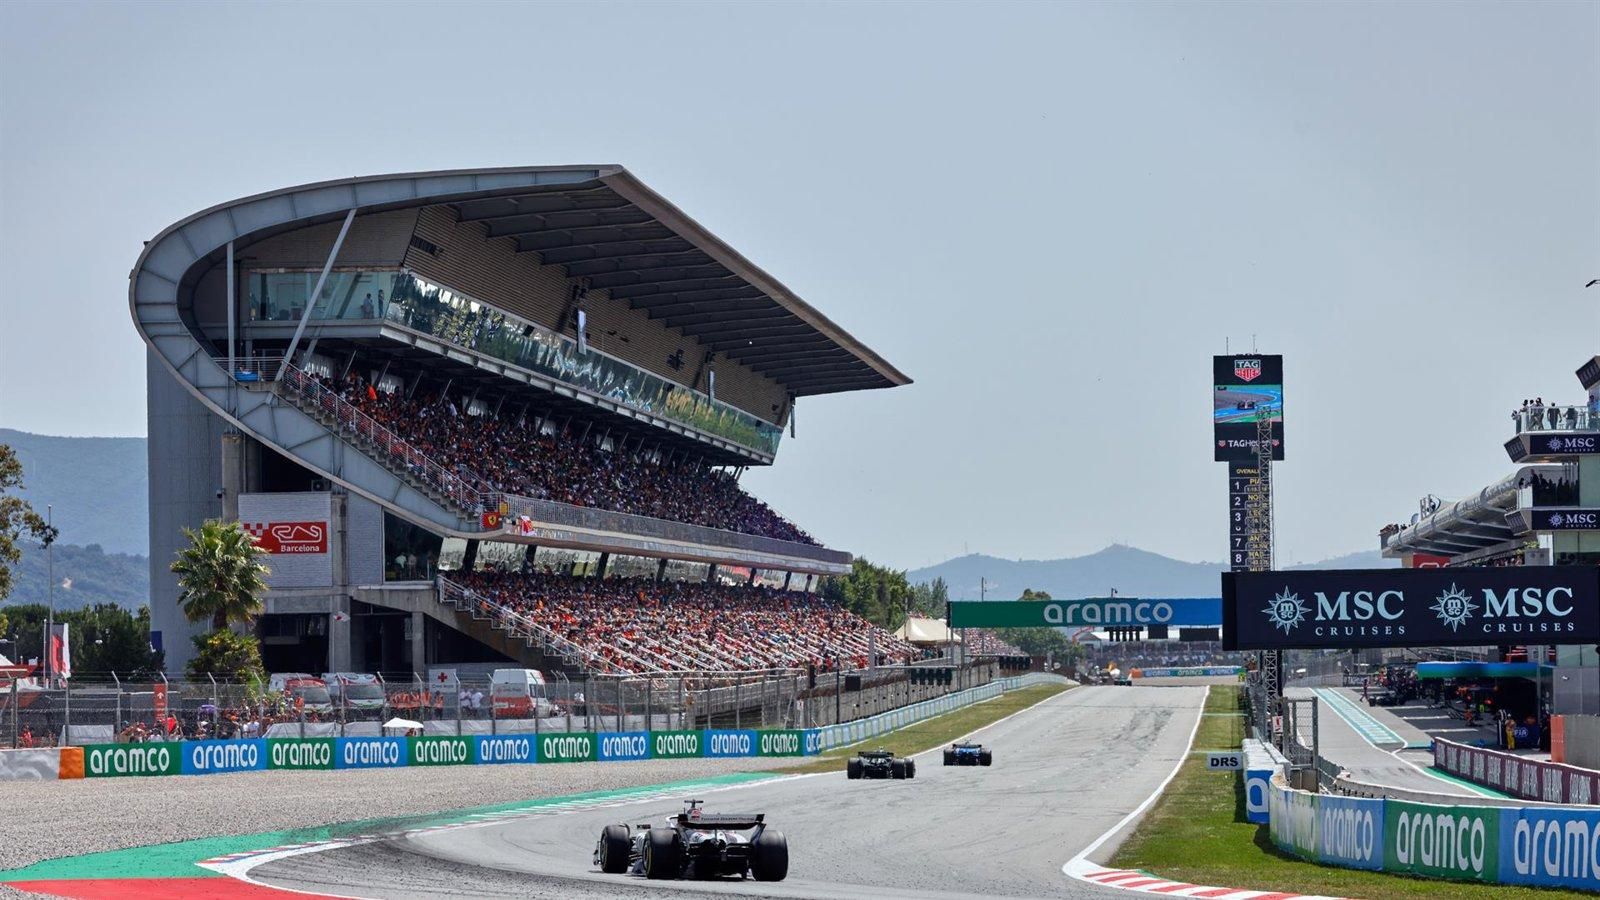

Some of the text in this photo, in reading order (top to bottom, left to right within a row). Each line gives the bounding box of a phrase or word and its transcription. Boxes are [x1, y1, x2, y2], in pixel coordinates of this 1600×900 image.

[1564, 438, 1595, 448] MSC
[1235, 481, 1240, 490] 1
[1235, 497, 1241, 506] 2
[1235, 512, 1241, 522] 3
[1566, 514, 1596, 523] MSC
[1235, 538, 1242, 547] 7
[1235, 554, 1242, 563] 8
[1043, 602, 1173, 624] aramco
[1314, 590, 1404, 621] MSC
[1481, 587, 1574, 618] MSC
[1315, 626, 1405, 636] CRUISES
[1483, 622, 1574, 632] CRUISES
[271, 742, 331, 766] aramco
[344, 741, 399, 764] aramco
[415, 740, 467, 763] aramco
[481, 739, 529, 761] aramco
[543, 737, 591, 759] aramco
[603, 736, 647, 758] aramco
[656, 734, 698, 755] aramco
[711, 734, 750, 754] aramco
[761, 733, 799, 754] aramco
[89, 748, 170, 774] aramco
[193, 745, 257, 770] aramco
[1210, 757, 1239, 767] DRS
[1323, 808, 1373, 861] aramco
[1396, 811, 1485, 872] aramco
